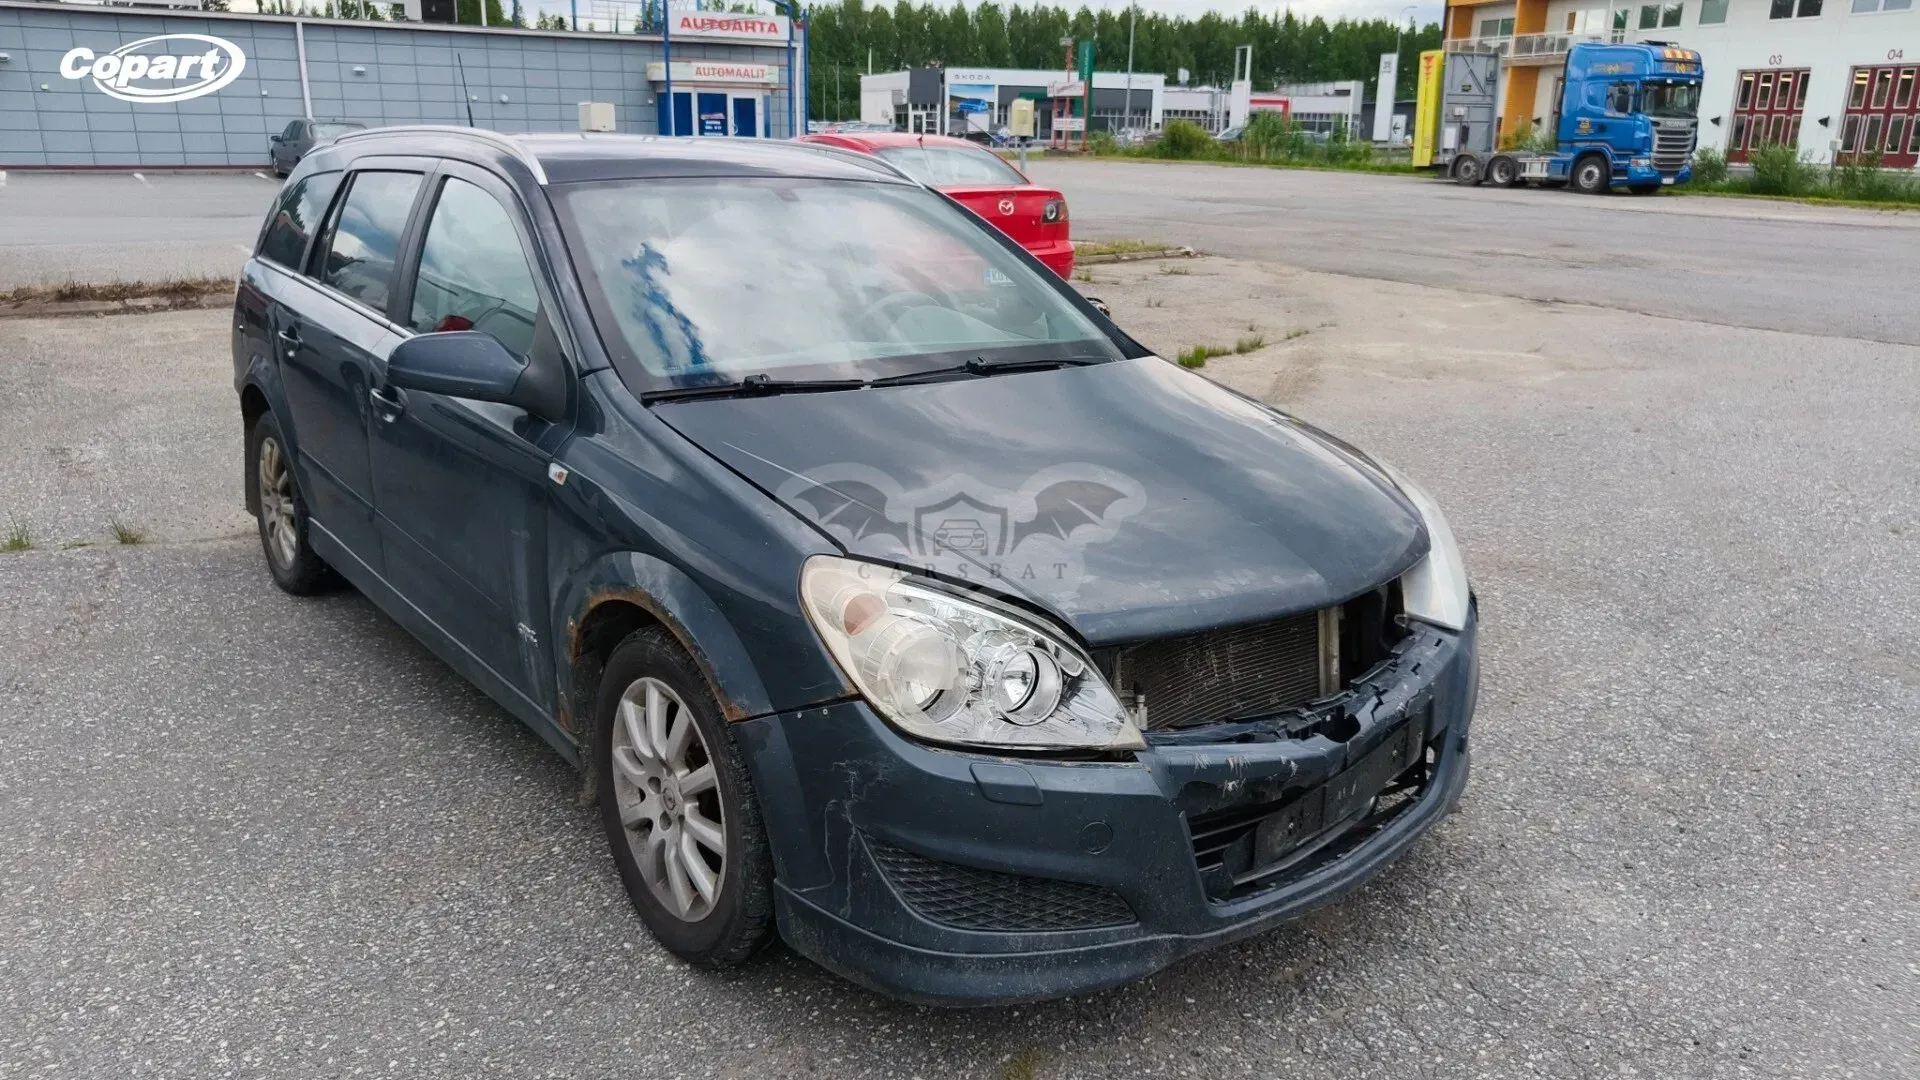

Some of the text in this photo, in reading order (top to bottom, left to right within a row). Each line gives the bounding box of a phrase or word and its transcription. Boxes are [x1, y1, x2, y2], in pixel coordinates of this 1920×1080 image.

[1769, 55, 1783, 65] 03
[1887, 49, 1903, 60] 04
[695, 66, 766, 79] AUTOMAALIT
